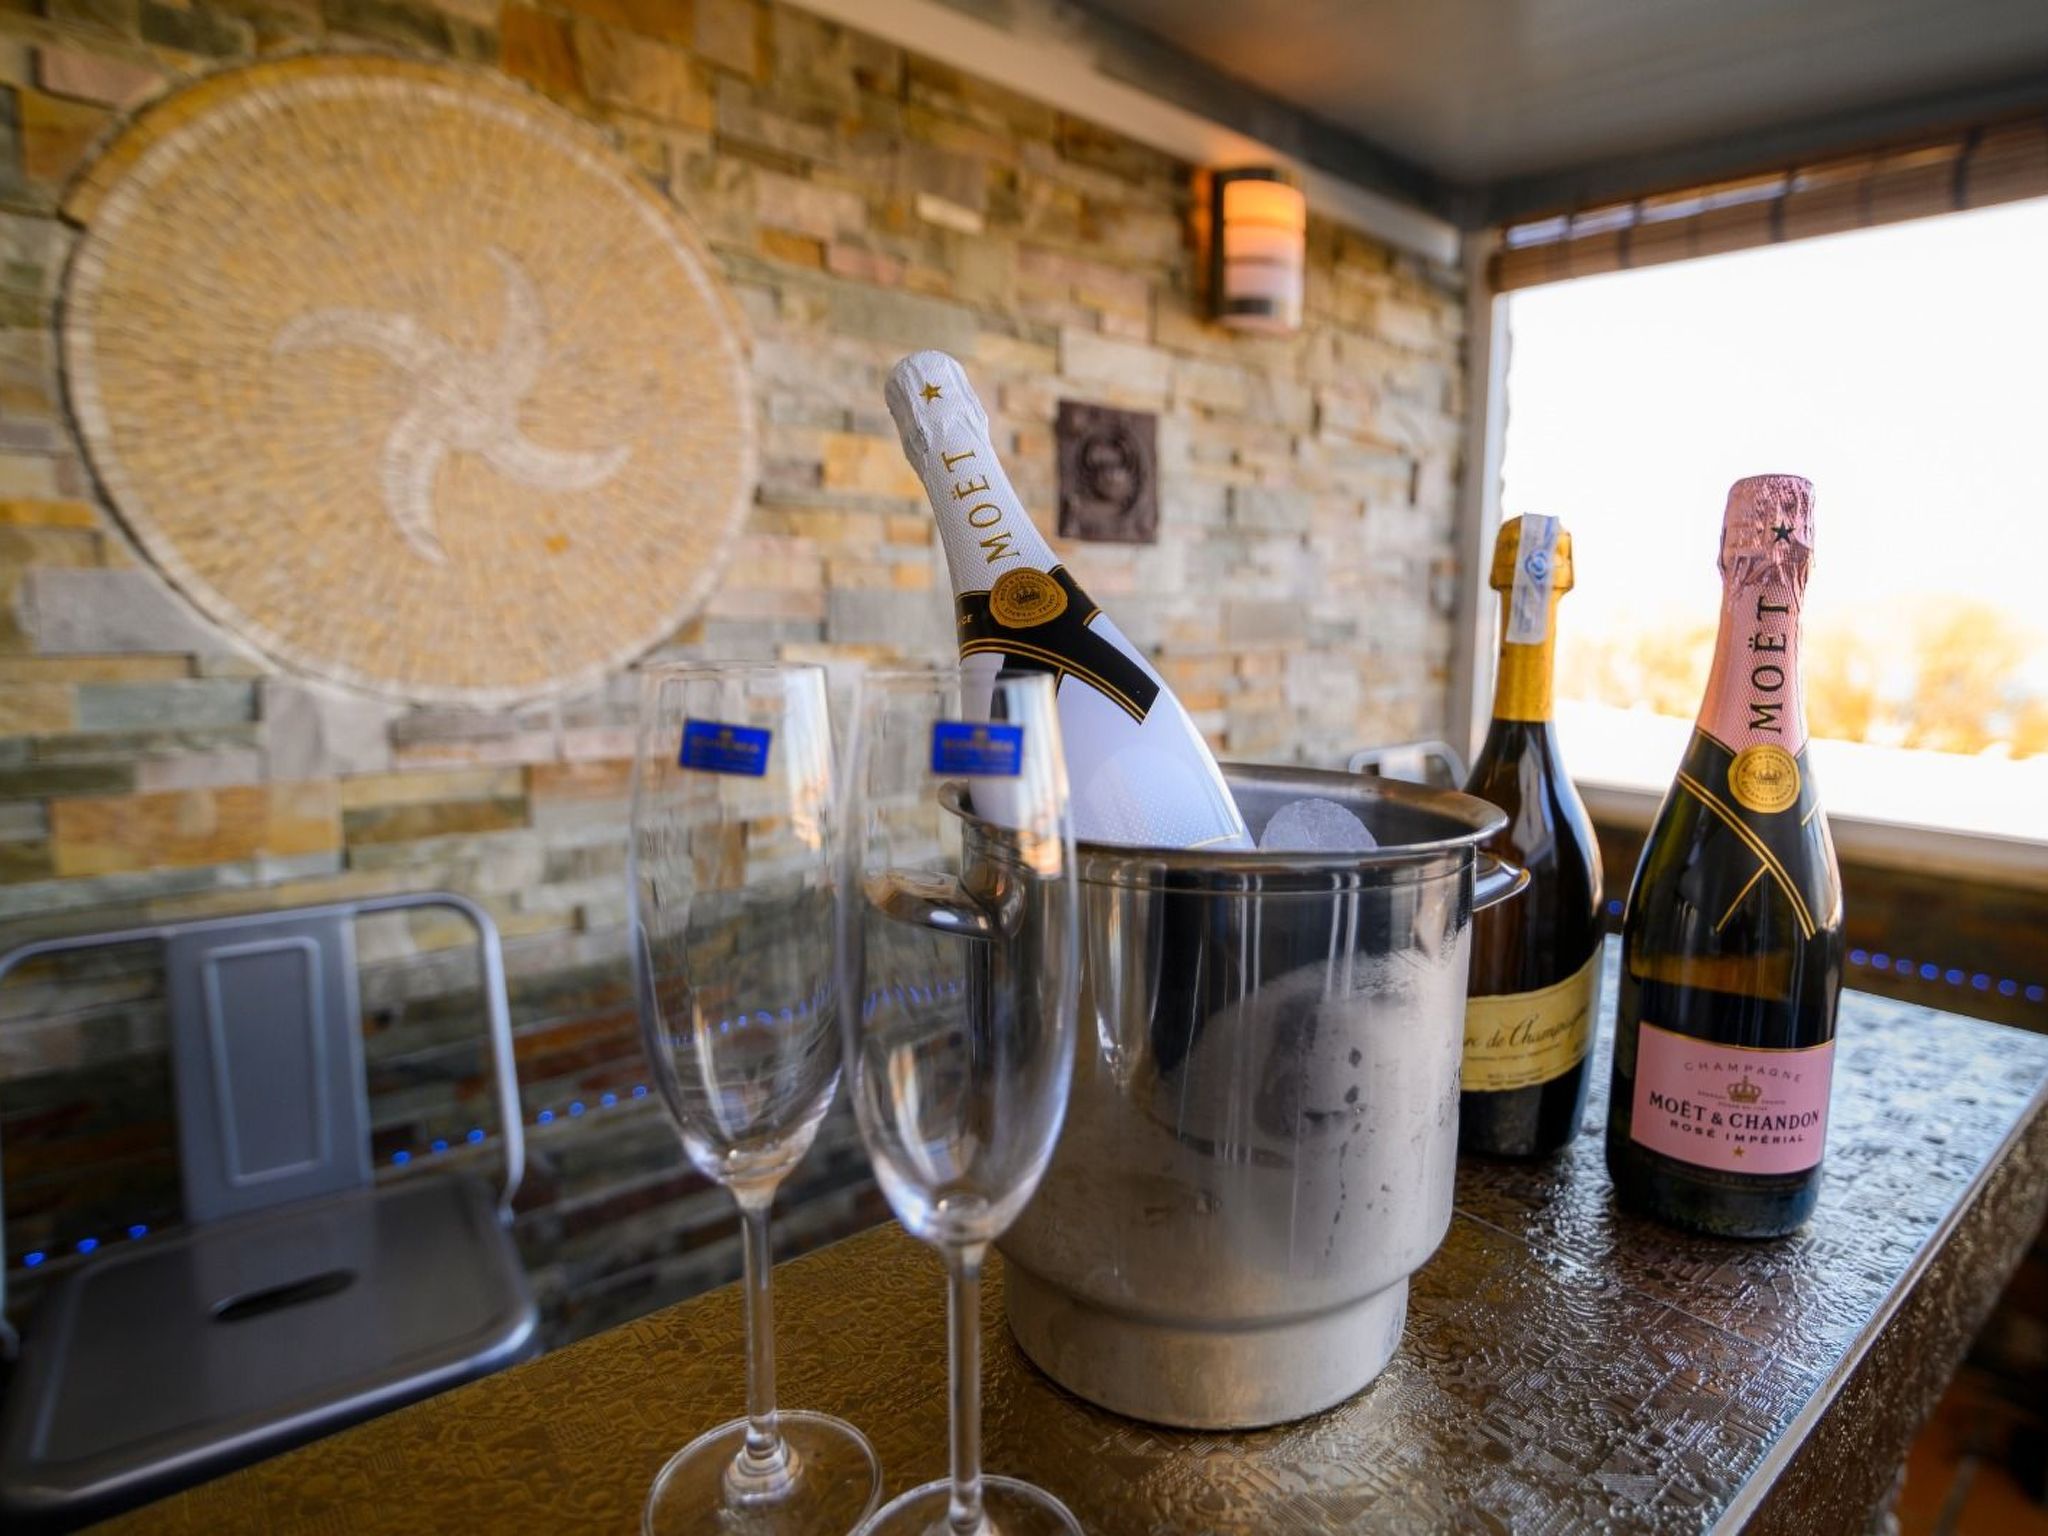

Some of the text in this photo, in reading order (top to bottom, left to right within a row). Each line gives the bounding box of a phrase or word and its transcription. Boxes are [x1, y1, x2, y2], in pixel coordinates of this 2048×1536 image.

[941, 450, 1021, 565] MOËT
[1748, 595, 1790, 733] MOËT
[1684, 1061, 1803, 1083] CHAMPAGNE
[1649, 1090, 1707, 1122] MOËT
[1711, 1112, 1723, 1126] &
[1729, 1109, 1820, 1132] CHANDON
[1670, 1119, 1804, 1144] ROSÉ IMPÉRIAL
